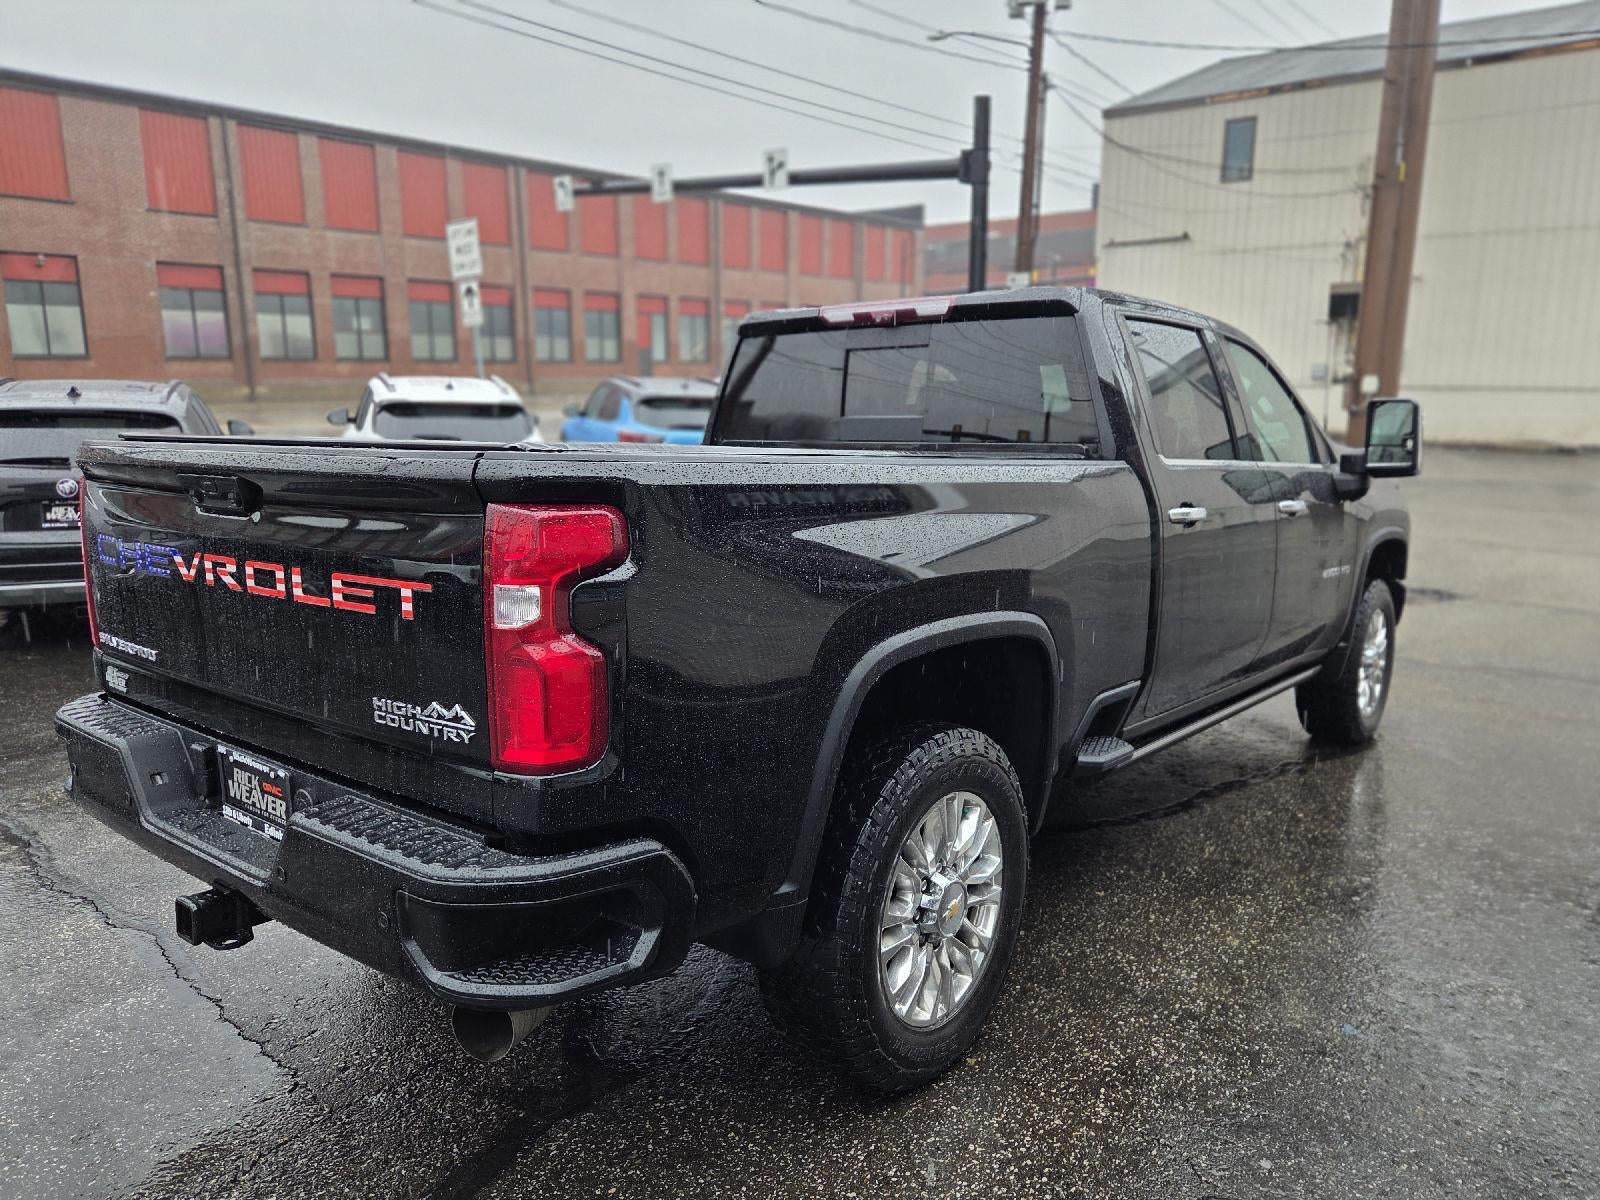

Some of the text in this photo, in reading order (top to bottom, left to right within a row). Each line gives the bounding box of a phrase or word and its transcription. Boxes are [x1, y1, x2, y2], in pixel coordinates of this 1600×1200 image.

[97, 533, 432, 620] CHEVROLET
[372, 697, 421, 719] HIGH
[373, 711, 476, 744] COUNTRY
[233, 767, 259, 789] RICK
[228, 779, 287, 820] WEAVER
